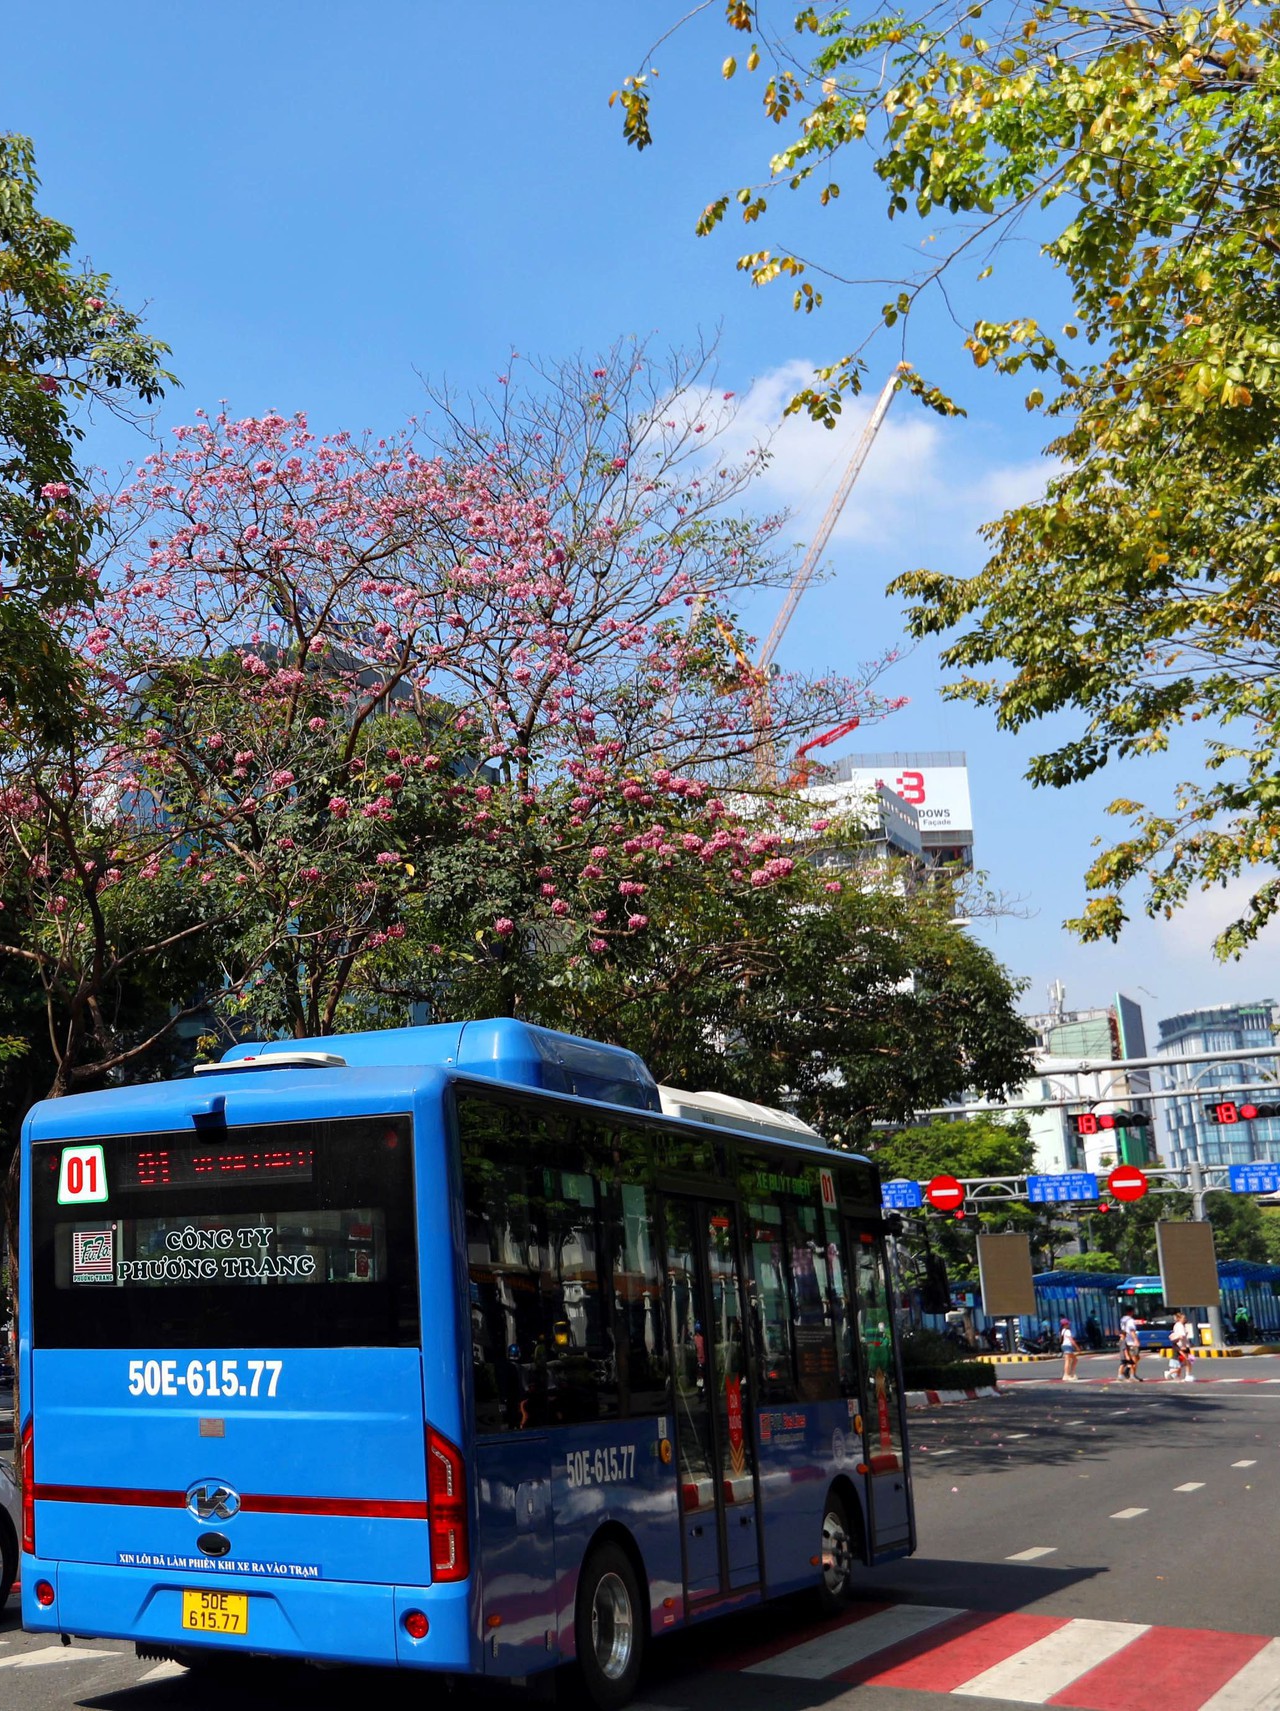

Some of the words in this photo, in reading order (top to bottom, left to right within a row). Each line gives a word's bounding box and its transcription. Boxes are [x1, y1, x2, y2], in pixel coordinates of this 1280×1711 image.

[918, 809, 951, 818] DOWS
[923, 818, 952, 827] Façade
[1078, 1113, 1097, 1135] 18
[1217, 1103, 1238, 1124] 18
[67, 1155, 98, 1195] 01
[822, 1174, 834, 1203] 01
[166, 1225, 234, 1252] CÔNG
[236, 1227, 274, 1249] TY
[117, 1255, 219, 1281] PHƯƠNG
[222, 1255, 316, 1278] TRANG
[128, 1359, 283, 1398] 50E-615.77
[566, 1444, 636, 1488] 50E-615.77
[119, 1553, 135, 1564] XIN
[153, 1554, 165, 1566] ĐÃ
[167, 1554, 187, 1568] LÀM
[217, 1559, 235, 1571] KHI
[236, 1560, 250, 1572] XE
[251, 1561, 266, 1573] RA
[266, 1561, 288, 1574] VÀO
[288, 1564, 319, 1578] TRẠM
[201, 1592, 229, 1611] 50E
[189, 1610, 240, 1631] 615.77
